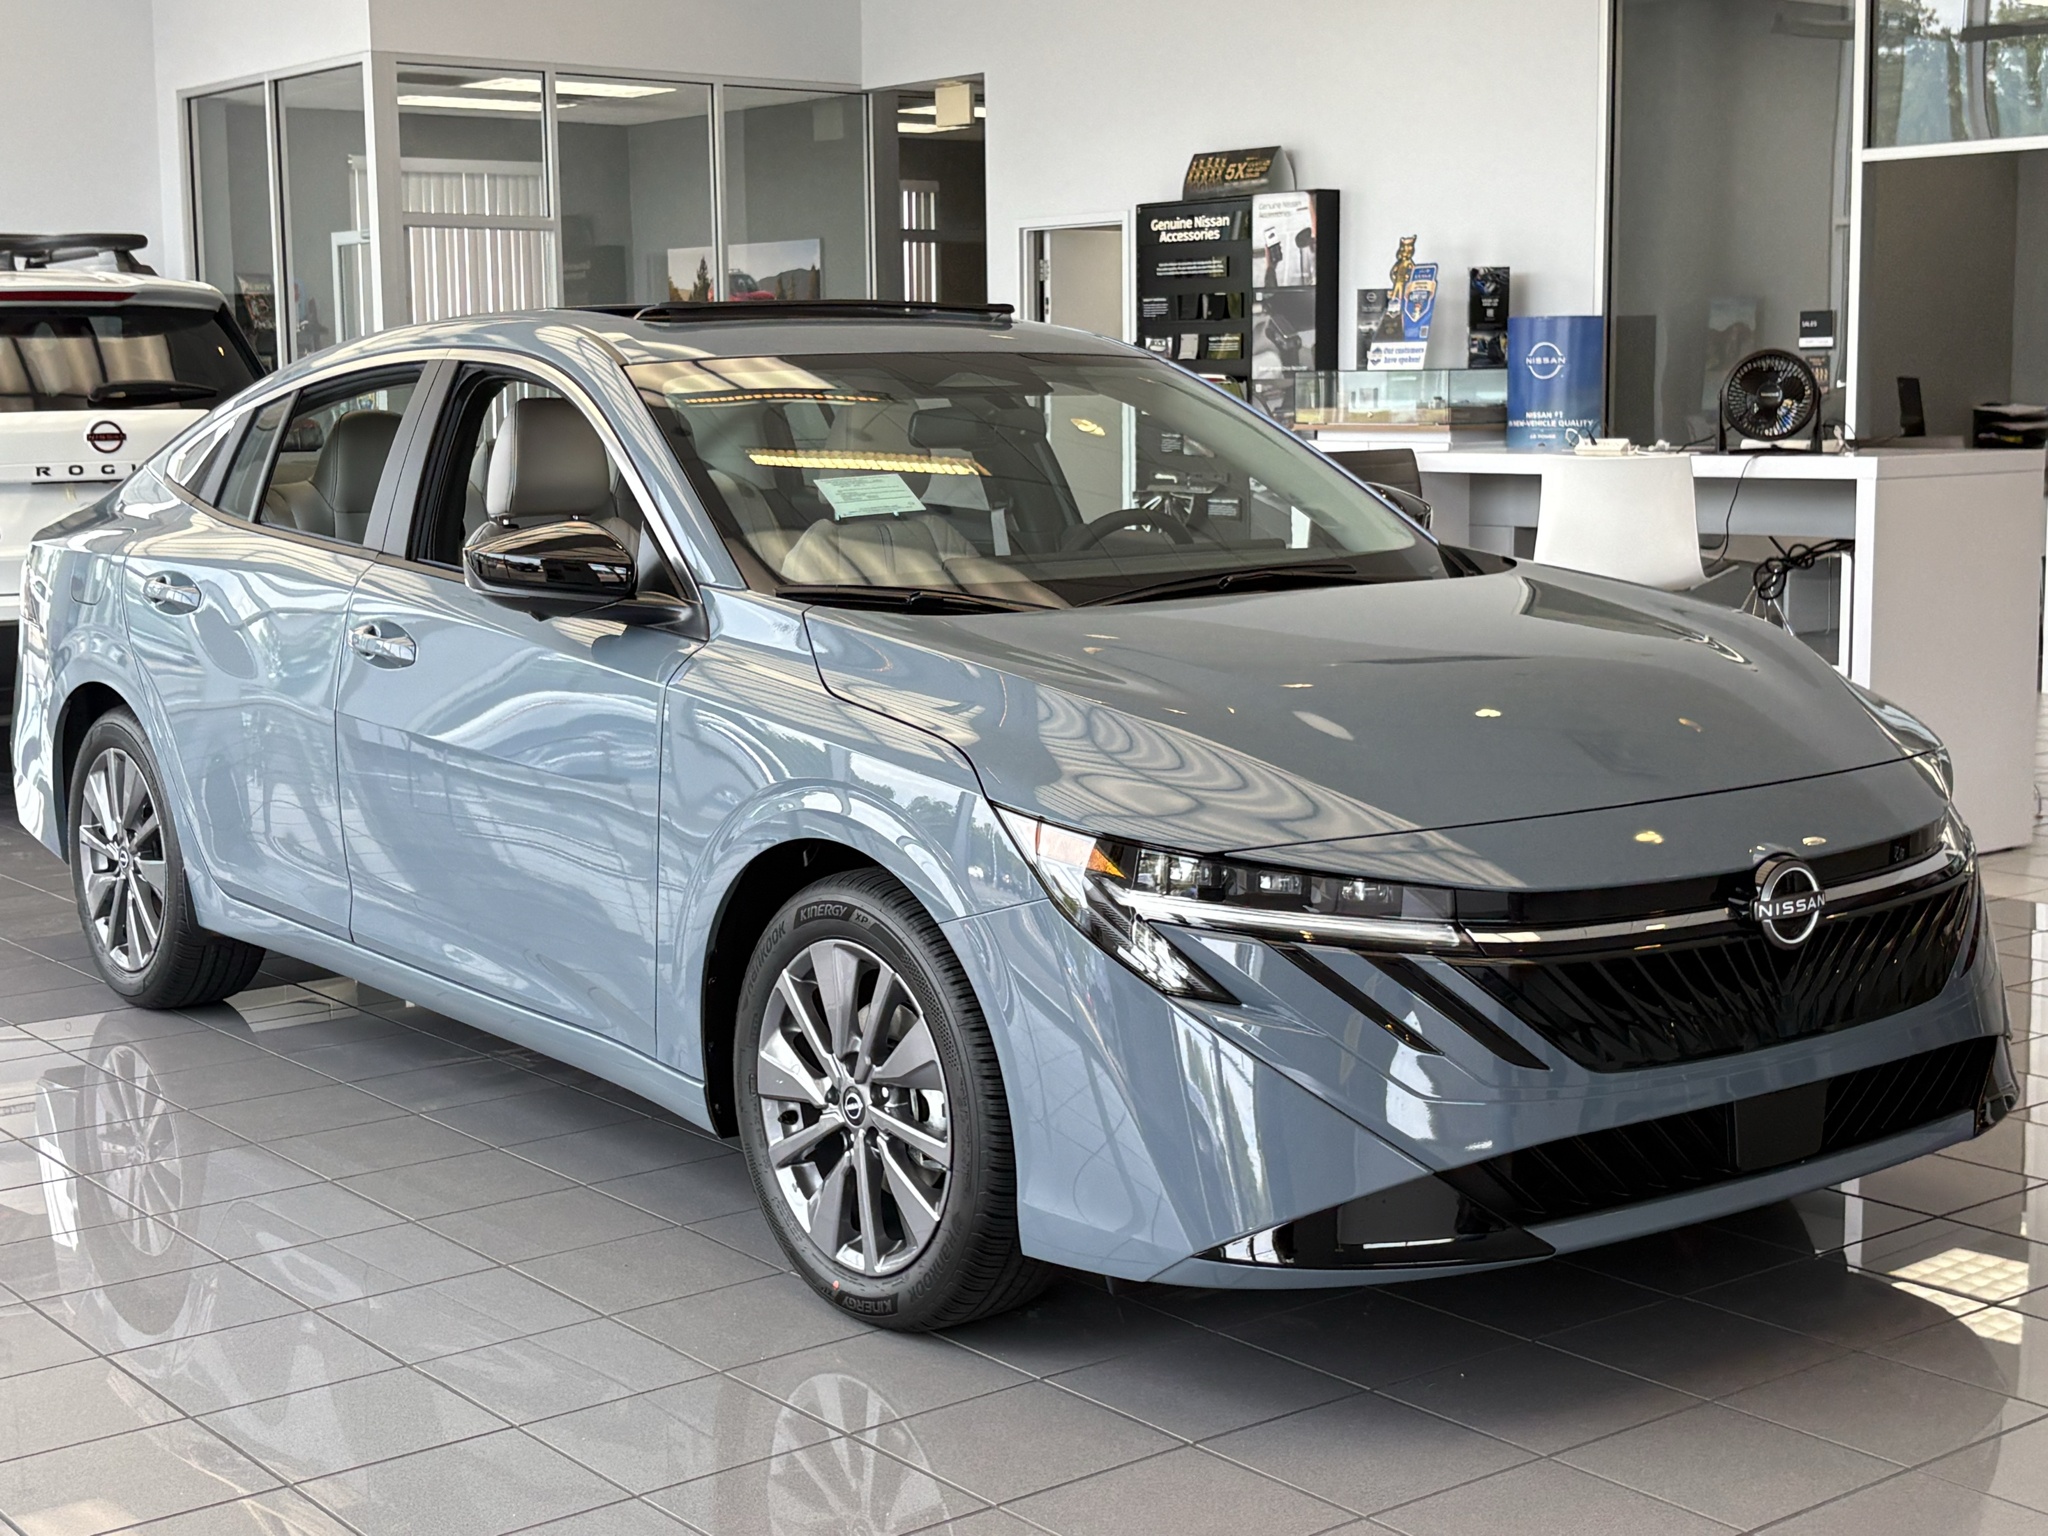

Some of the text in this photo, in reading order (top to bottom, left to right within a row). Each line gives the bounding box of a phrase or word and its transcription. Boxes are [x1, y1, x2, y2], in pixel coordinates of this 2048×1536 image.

[1224, 162, 1249, 180] 5X
[1150, 215, 1230, 231] Genuine Nissan
[1159, 228, 1221, 243] Accessories
[1525, 357, 1566, 365] NISSAN
[1558, 419, 1594, 427] QUALITY
[1758, 893, 1825, 918] NISSAN
[855, 912, 869, 923] XP
